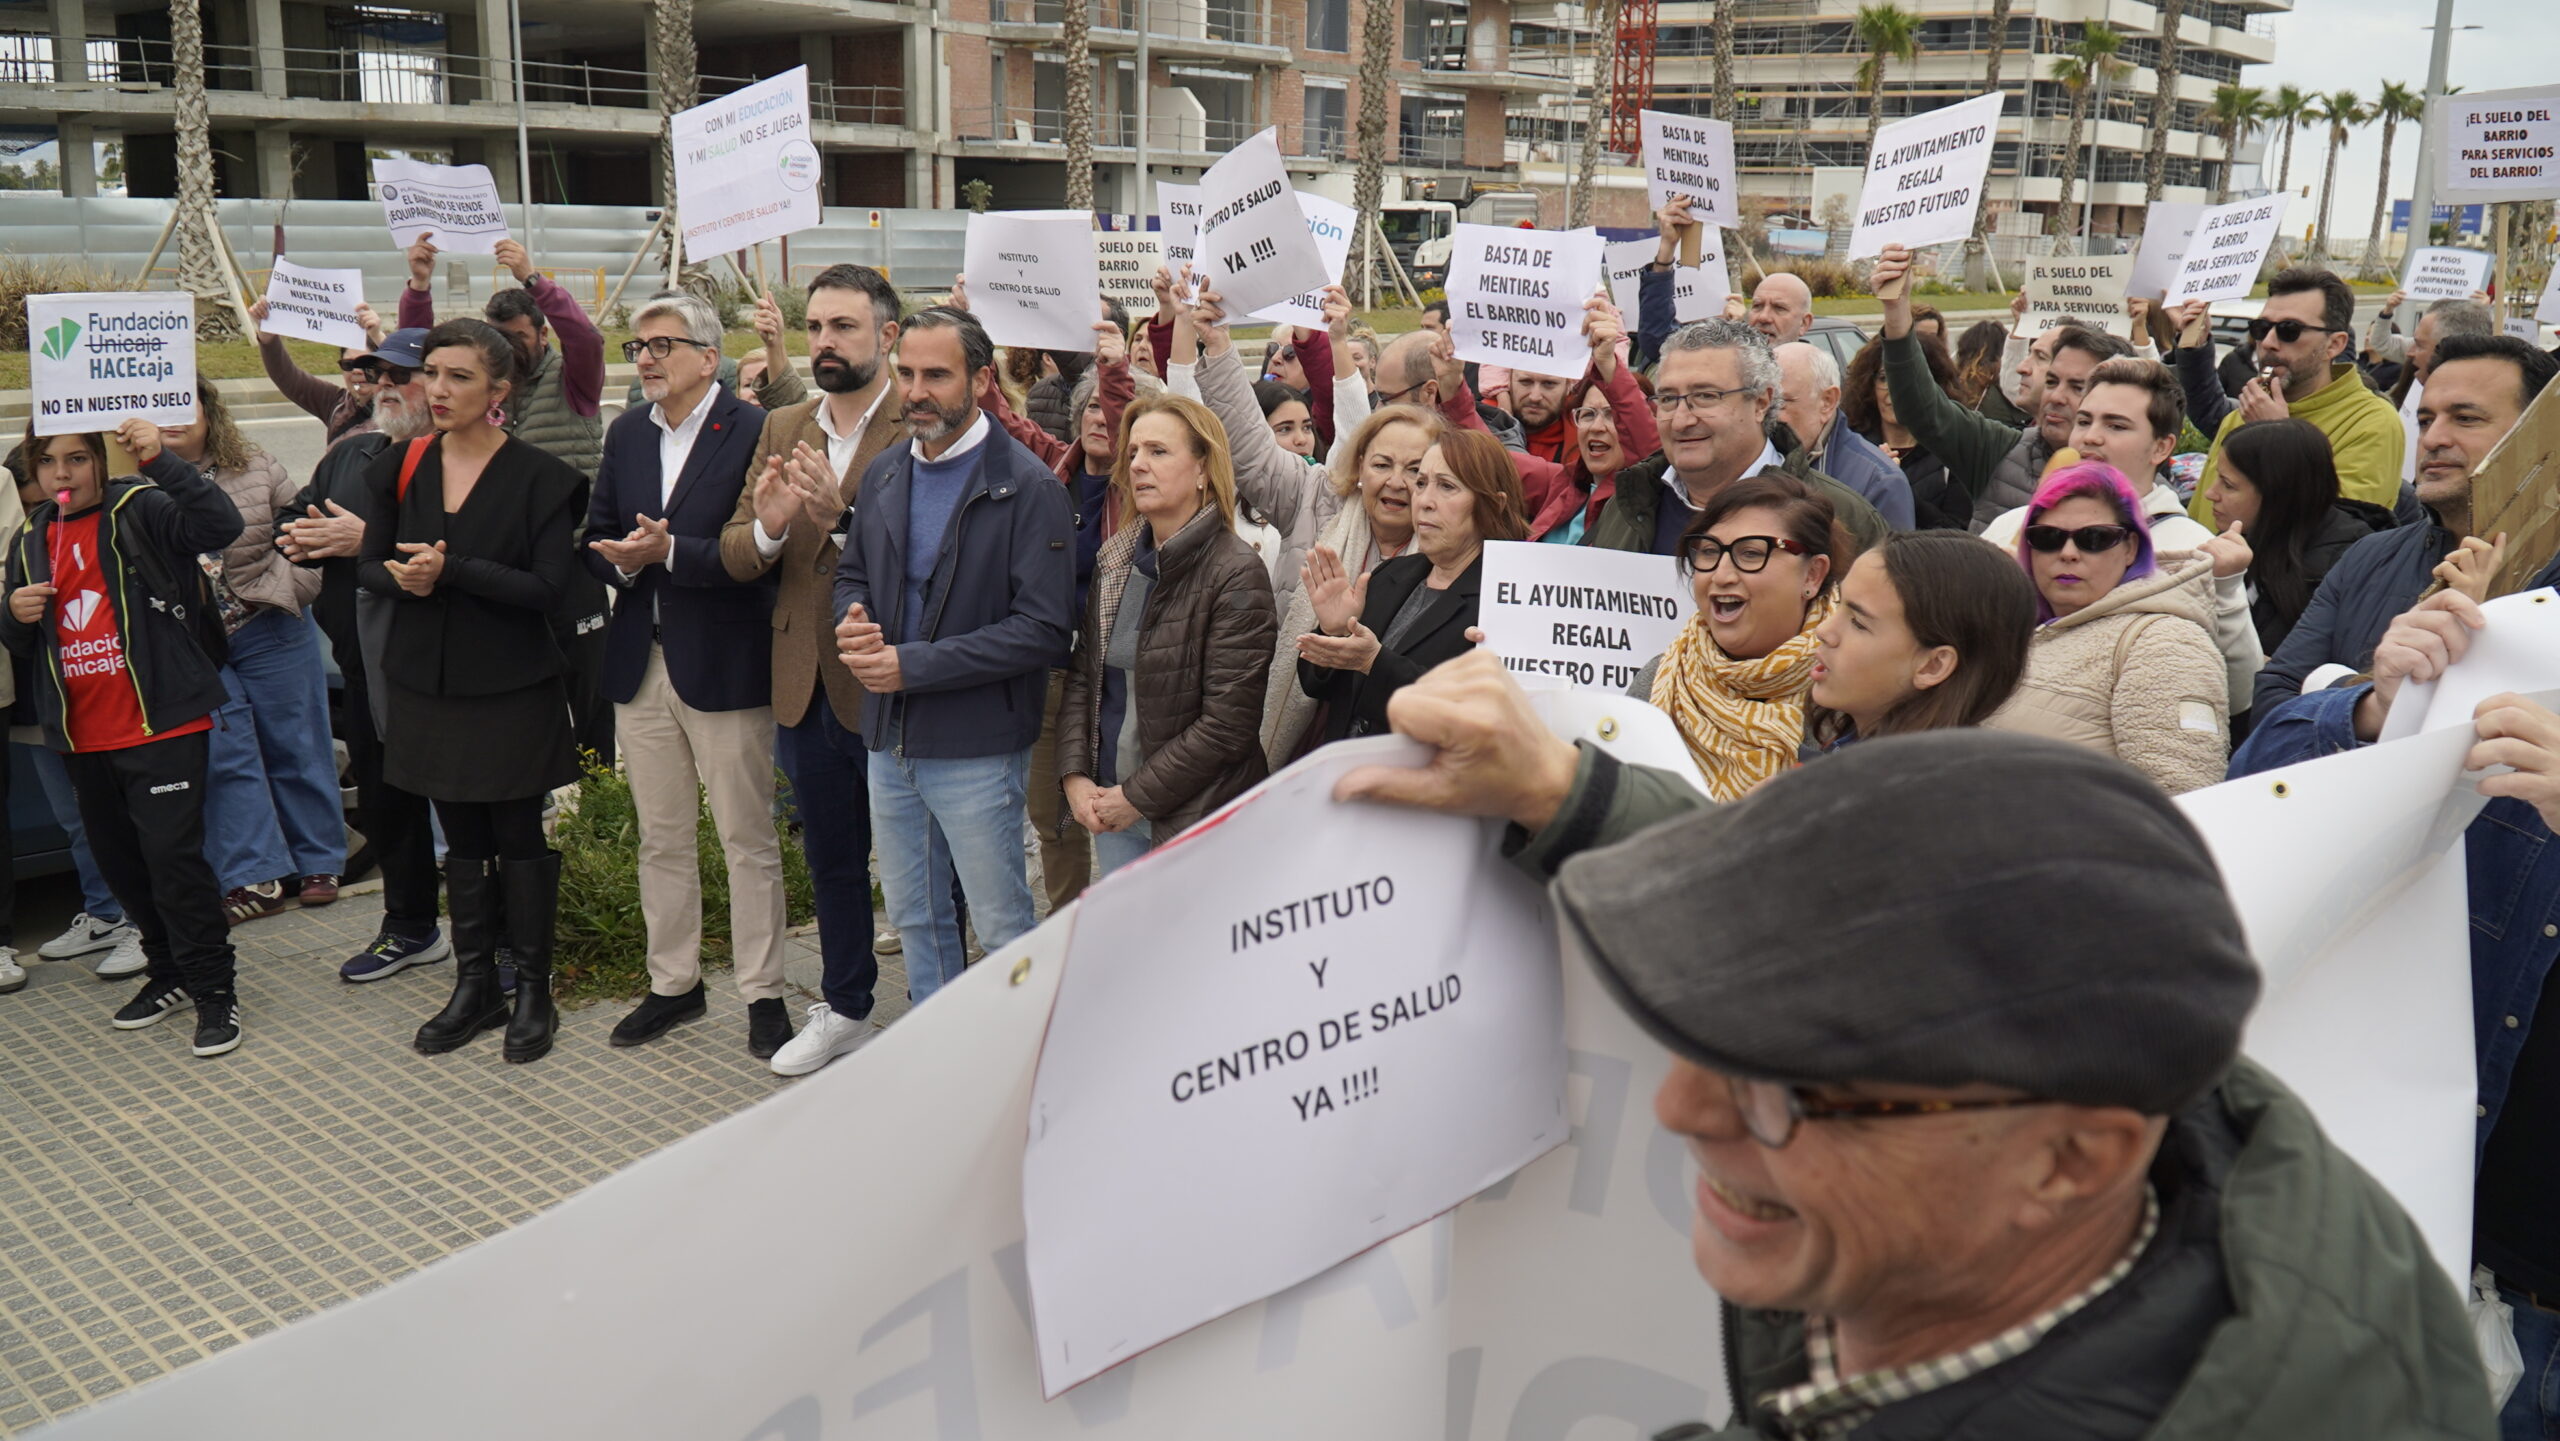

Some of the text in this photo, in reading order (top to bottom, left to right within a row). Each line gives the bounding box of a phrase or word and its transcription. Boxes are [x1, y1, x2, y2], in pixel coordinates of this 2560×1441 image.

[705, 88, 793, 134] CON MI EDUCACIÓN
[2466, 110, 2550, 128] ¡EL SUELO DEL
[688, 113, 802, 165] Y MI SALUD NO SE JUEGA
[1662, 126, 1706, 145] BASTA DE
[2484, 130, 2528, 142] BARRIO
[1664, 147, 1709, 168] MENTIRAS
[1874, 125, 1985, 171] EL AYUNTAMIENTO
[2462, 147, 2554, 160] PARA SERVICIOS
[1657, 168, 1720, 192] EL BARRIO NO
[1897, 165, 1944, 192] REGALA
[2470, 166, 2542, 178] DEL BARRIO!
[403, 195, 413, 205] EL
[434, 201, 446, 210] NO
[447, 202, 456, 211] SE
[456, 201, 483, 212] VENDE
[1171, 202, 1195, 216] ESTA
[1205, 206, 1230, 235] CENTRO
[1232, 198, 1245, 217] DE
[1246, 180, 1282, 208] SALUD
[1863, 188, 1969, 227] NUESTRO FUTURO
[486, 212, 501, 222] YA!
[718, 220, 722, 229] Y
[723, 212, 745, 228] CENTRO
[747, 210, 755, 220] DE
[756, 203, 778, 217] SALUD
[2205, 218, 2219, 234] ¡EL
[2222, 211, 2252, 227] SUELO
[2254, 206, 2273, 220] DEL
[1099, 242, 1159, 253] SUELO DEL
[2212, 232, 2249, 249] BARRIO
[999, 253, 1038, 264] INSTITUTO
[1099, 261, 1139, 271] BARRIO
[1224, 237, 1277, 274] YA !!!!
[1485, 245, 1552, 268] BASTA DE
[2185, 250, 2259, 274] PARA SERVICIOS
[2440, 256, 2461, 264] PISOS
[1018, 269, 1023, 277] Y
[2033, 266, 2112, 280] ¡EL SUELO DEL
[2431, 266, 2465, 275] NEGOCIOS
[274, 271, 345, 293] ESTA PARCELA ES
[989, 282, 1061, 296] CENTRO DE SALUD
[1480, 274, 1549, 299] MENTIRAS
[2052, 285, 2092, 296] BARRIO
[2183, 273, 2241, 294] DEL BARRIO!
[290, 290, 331, 304] NUESTRA
[1018, 299, 1028, 308] YA
[2034, 301, 2119, 314] PARA SERVICIOS
[89, 311, 188, 332] Fundación
[307, 319, 323, 331] YA!
[1466, 302, 1566, 329] EL BARRIO NO
[2512, 324, 2524, 333] DEL
[90, 333, 161, 357] Unicaja
[1482, 330, 1554, 357] SE REGALA
[90, 356, 173, 382] HACEcaja
[42, 392, 191, 415] NO EN NUESTRO SUELO
[1498, 582, 1678, 620] EL AYUNTAMIENTO
[1552, 623, 1632, 651] REGALA
[1232, 876, 1394, 954] INSTITUTO
[1309, 957, 1328, 988] Y
[1171, 974, 1462, 1103] CENTRO DE SALUD
[1292, 1066, 1379, 1121] YA !!!!
